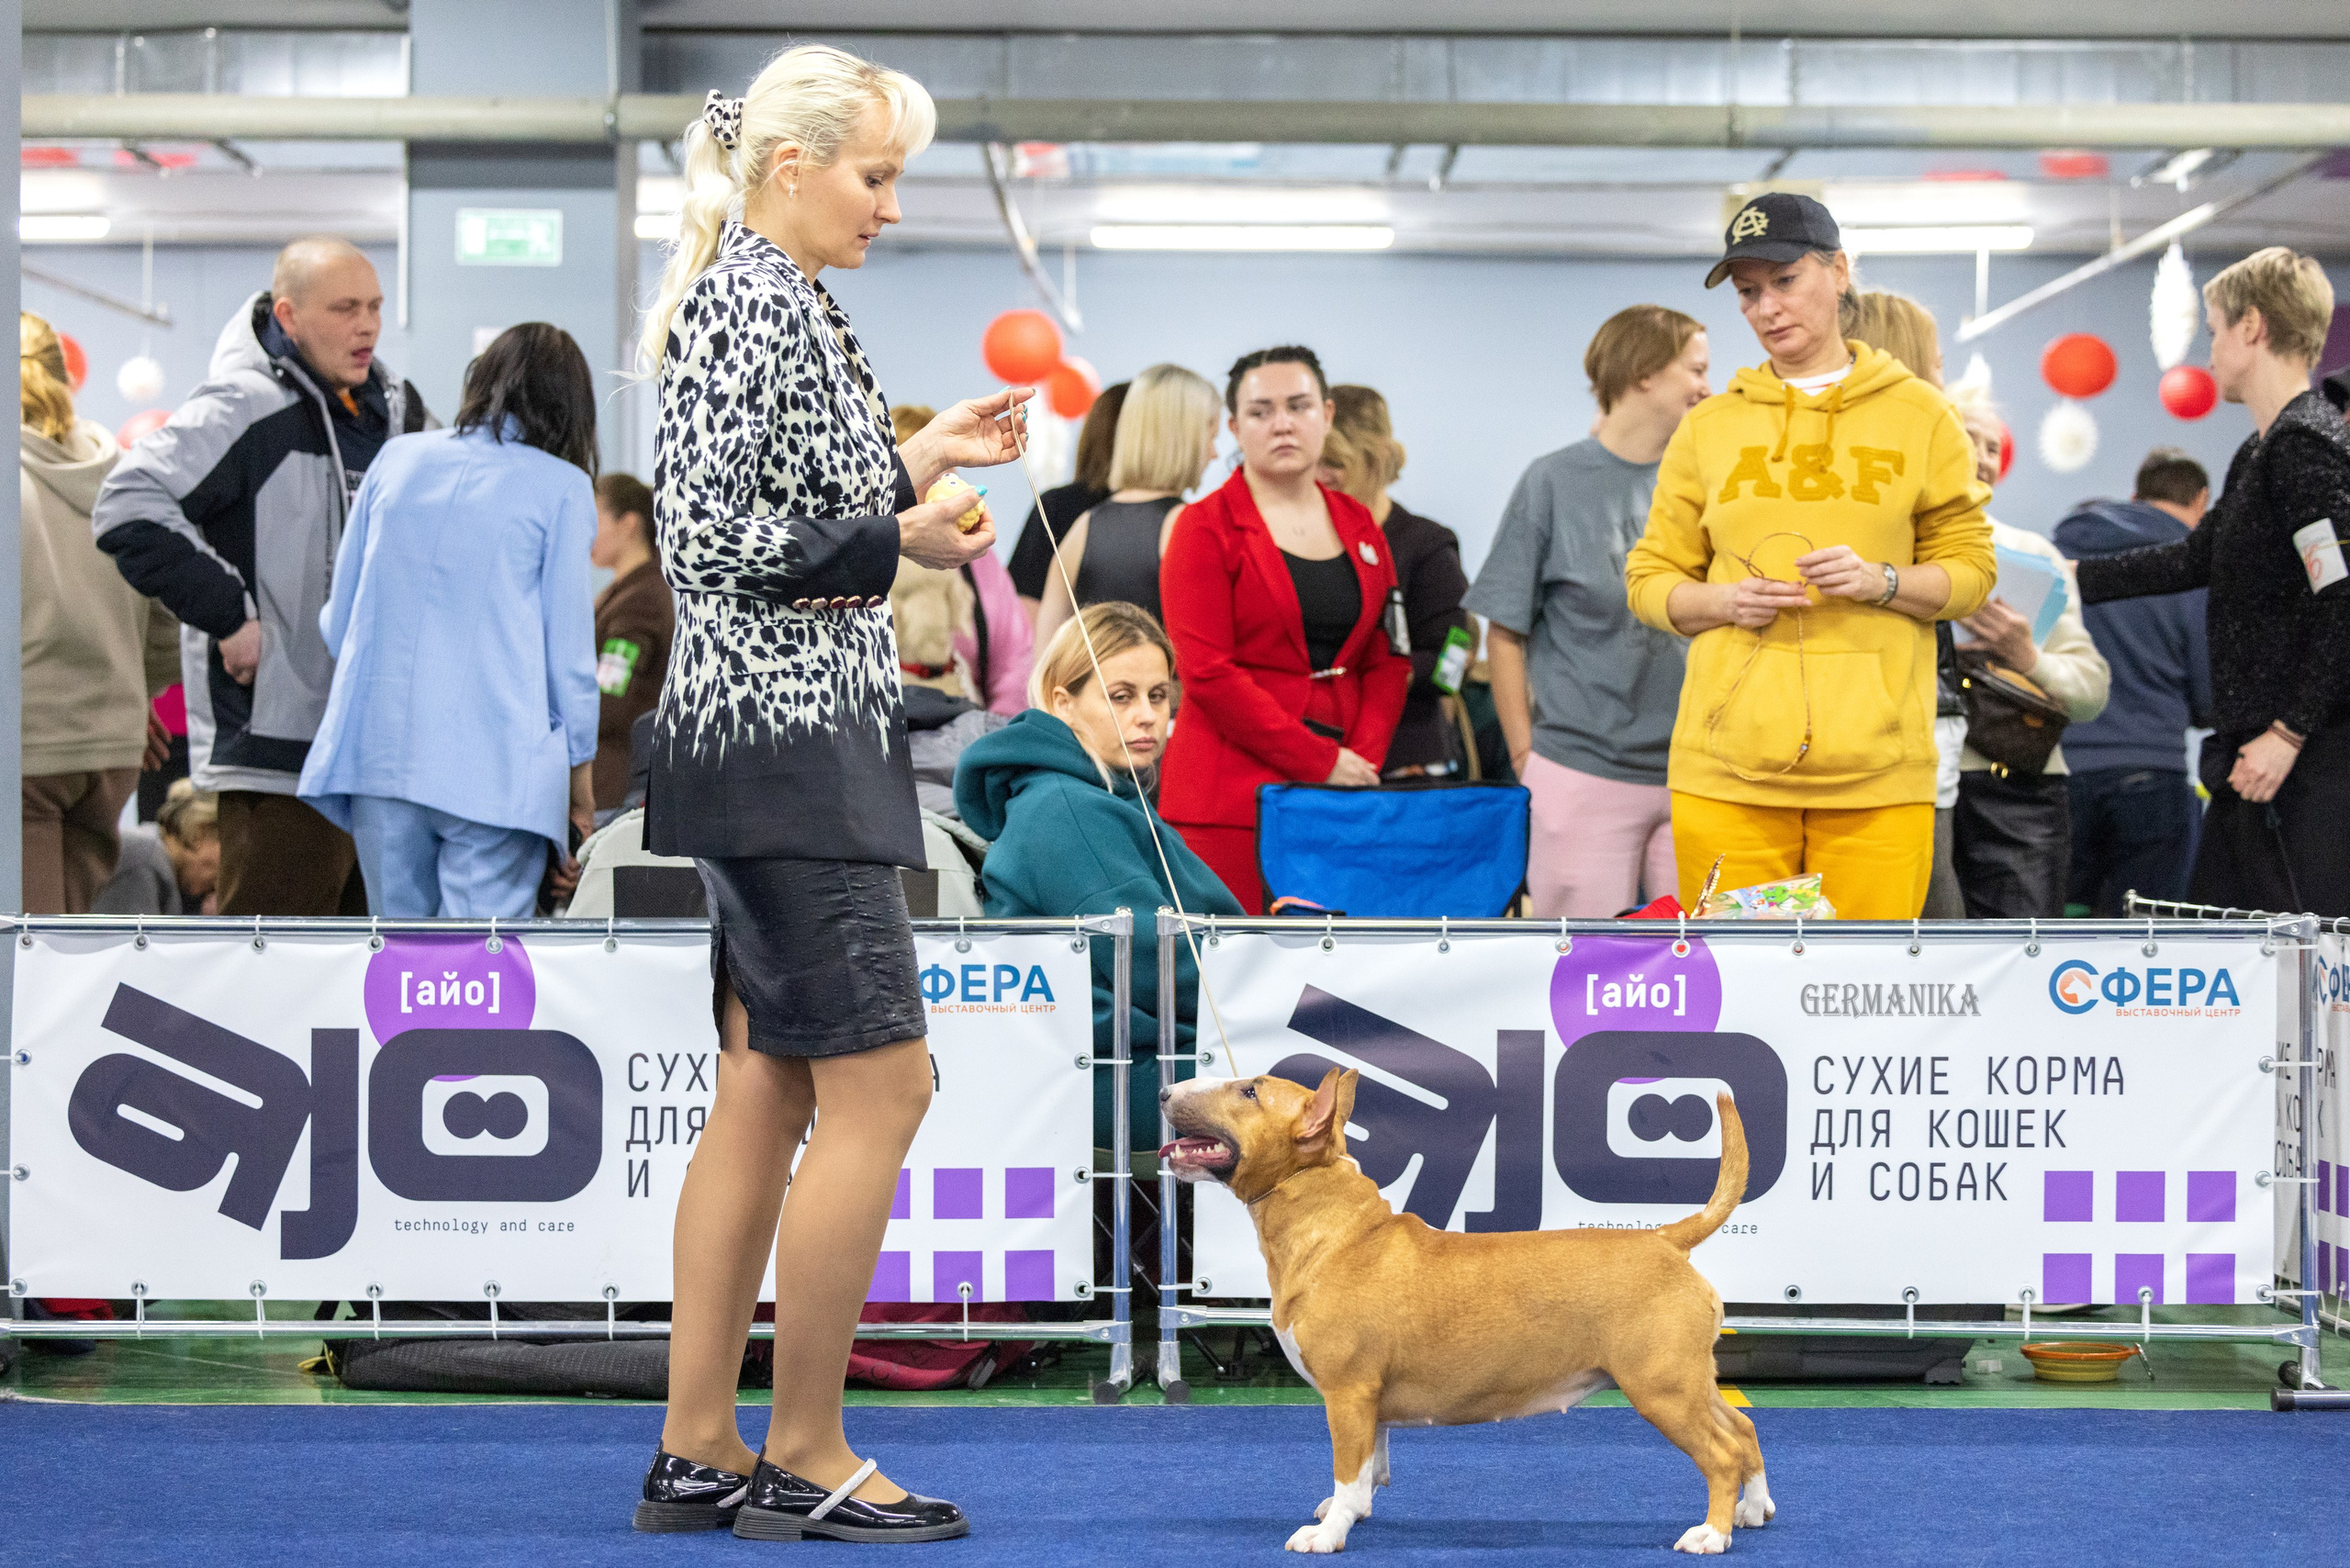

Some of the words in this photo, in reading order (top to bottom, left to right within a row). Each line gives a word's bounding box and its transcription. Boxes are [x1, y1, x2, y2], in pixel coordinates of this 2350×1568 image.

[1718, 442, 1906, 506] A&F
[1800, 982, 1982, 1019] GERMANIKA
[2048, 958, 2241, 1015] СФЕРА
[930, 1002, 1017, 1014] ВЫСТАВОЧНЫЙ
[1020, 1004, 1057, 1015] ЦЕНТР
[2115, 1006, 2201, 1017] ВЫСТАВОЧНЫЙ
[2205, 1008, 2242, 1018] ЦЕНТР
[628, 1052, 720, 1092] СУХ
[1813, 1055, 1951, 1096] СУХИЕ
[1987, 1055, 2125, 1097] КОРМА
[625, 1105, 707, 1153] ДЛЯ
[1809, 1108, 1891, 1156] ДЛЯ
[1928, 1109, 2067, 1148] КОШЕК
[628, 1159, 649, 1198] И
[1811, 1161, 1834, 1202] И
[1869, 1160, 2009, 1203] СОБАК
[394, 1218, 489, 1235] technology
[499, 1219, 527, 1232] and
[538, 1221, 576, 1232] care
[1721, 1223, 1758, 1235] care
